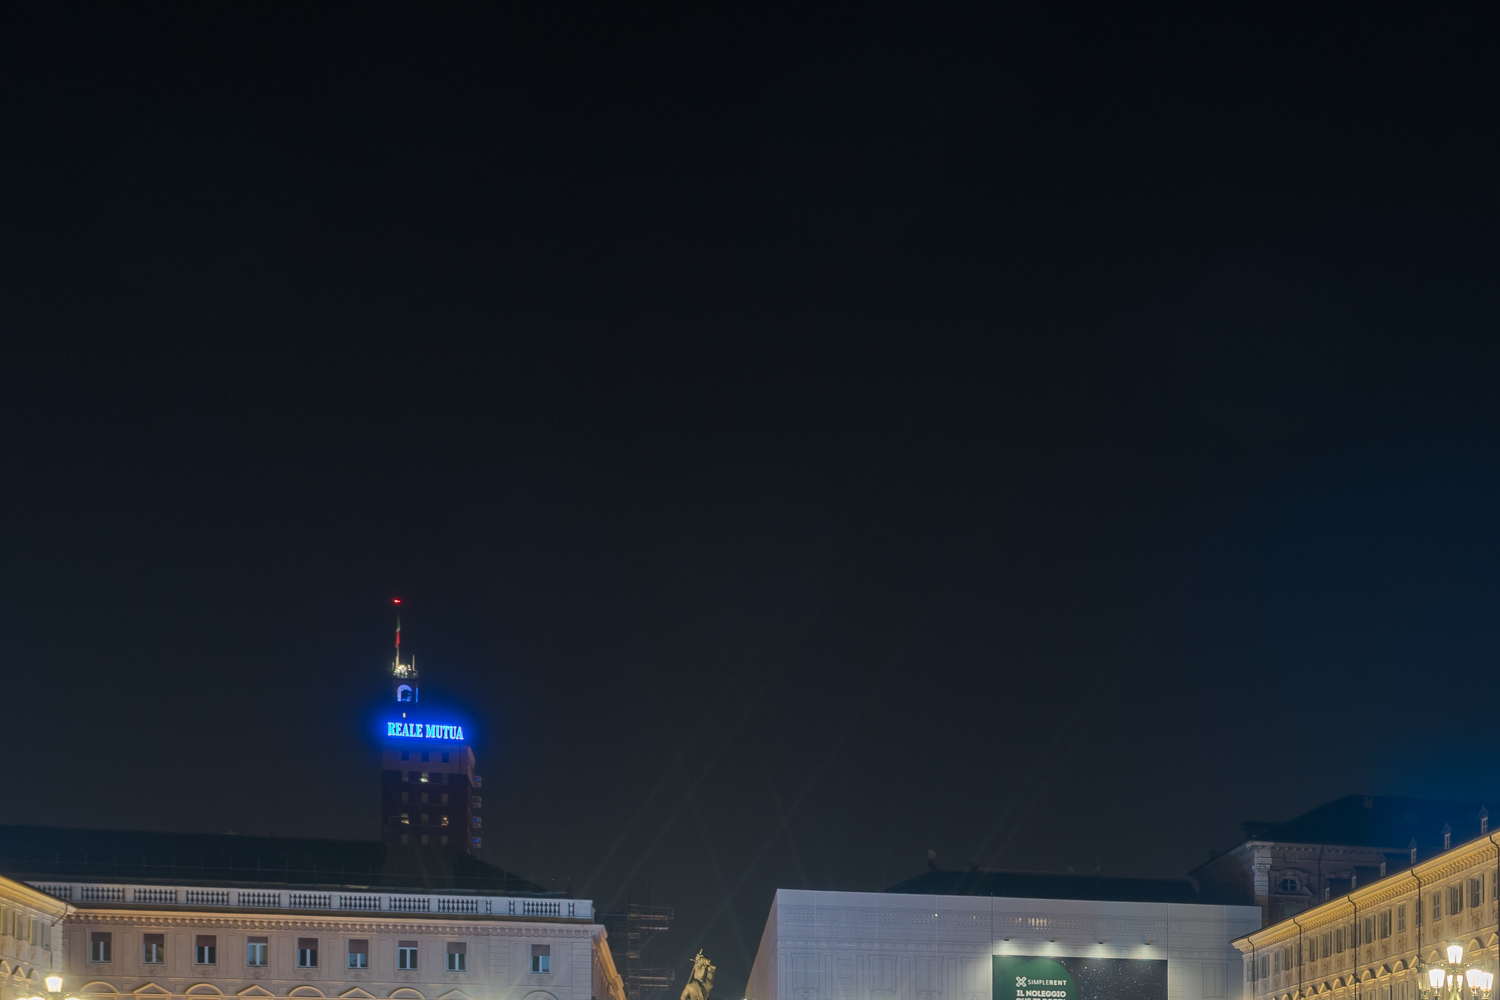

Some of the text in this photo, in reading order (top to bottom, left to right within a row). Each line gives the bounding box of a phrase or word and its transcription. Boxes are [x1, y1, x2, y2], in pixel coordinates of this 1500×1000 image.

[387, 722, 464, 740] REALE MUTUA
[1016, 989, 1067, 998] IL NOLEGGIO
